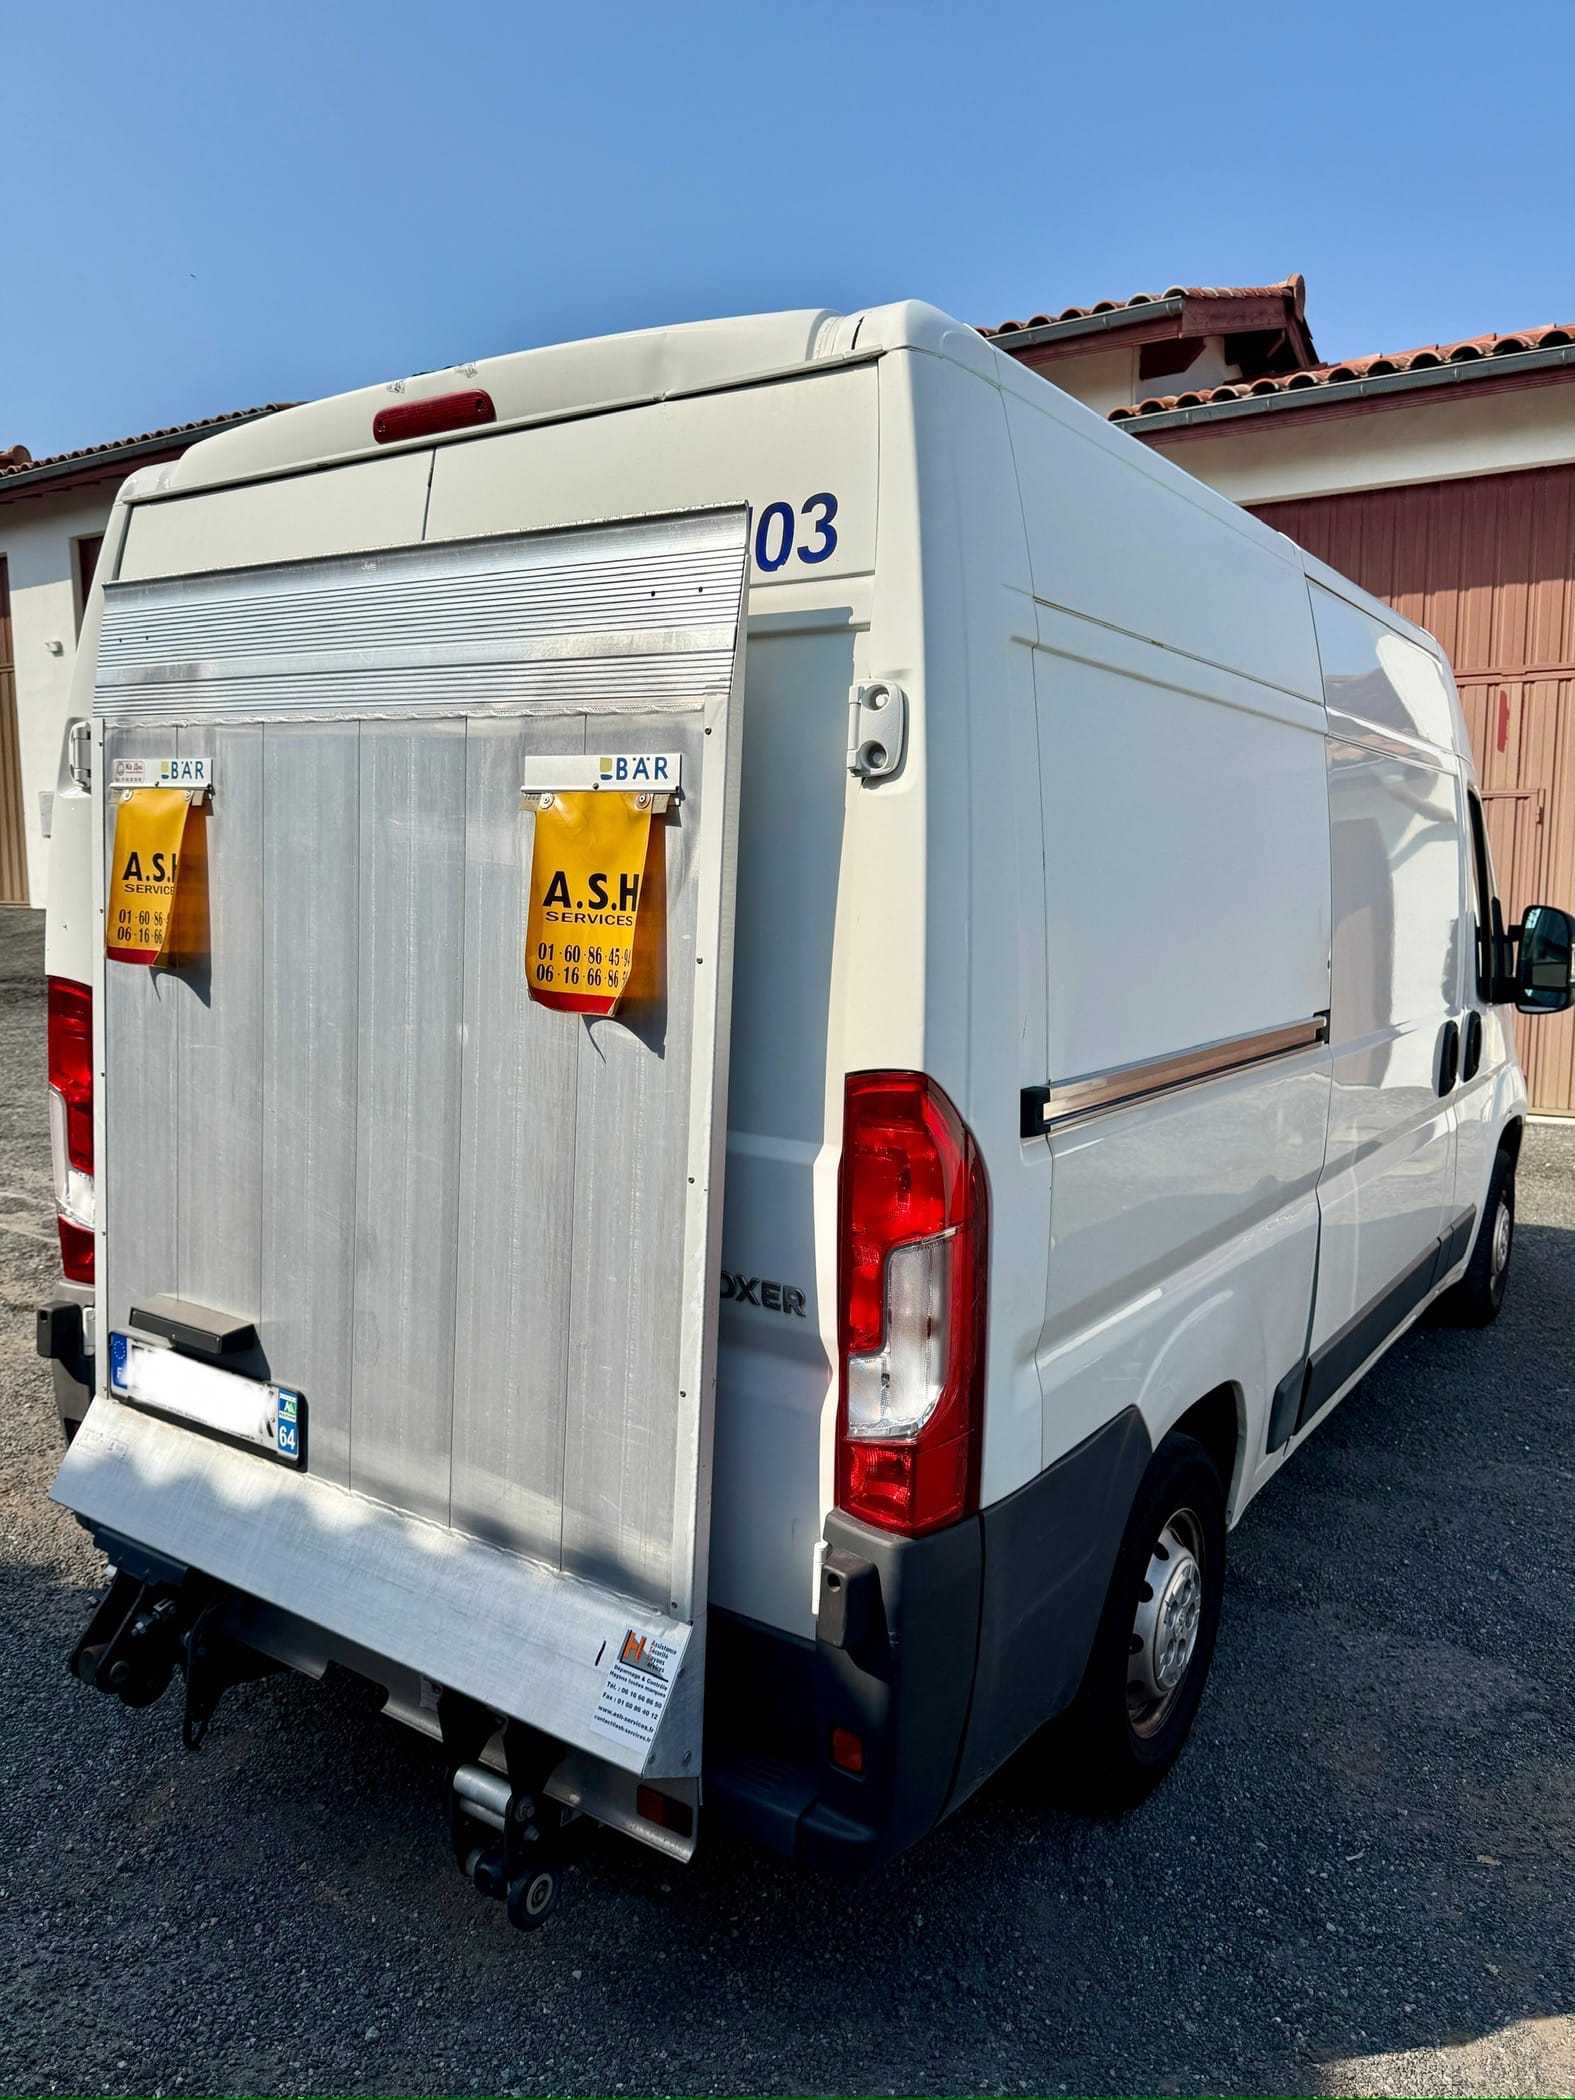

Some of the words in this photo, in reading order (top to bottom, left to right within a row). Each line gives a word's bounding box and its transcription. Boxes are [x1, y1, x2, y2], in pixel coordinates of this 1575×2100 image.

[749, 493, 838, 572] 03
[171, 761, 204, 779] BÄR
[616, 757, 669, 780] BÄR
[545, 911, 633, 926] SERVICES
[279, 1425, 296, 1450] 64
[609, 1670, 627, 1682] Hayons
[628, 1678, 644, 1689] toutes
[644, 1686, 666, 1699] marques
[613, 1664, 641, 1680] Dépannage
[647, 1678, 668, 1691] Contrôle
[598, 1705, 654, 1734] www.ash-services.fr
